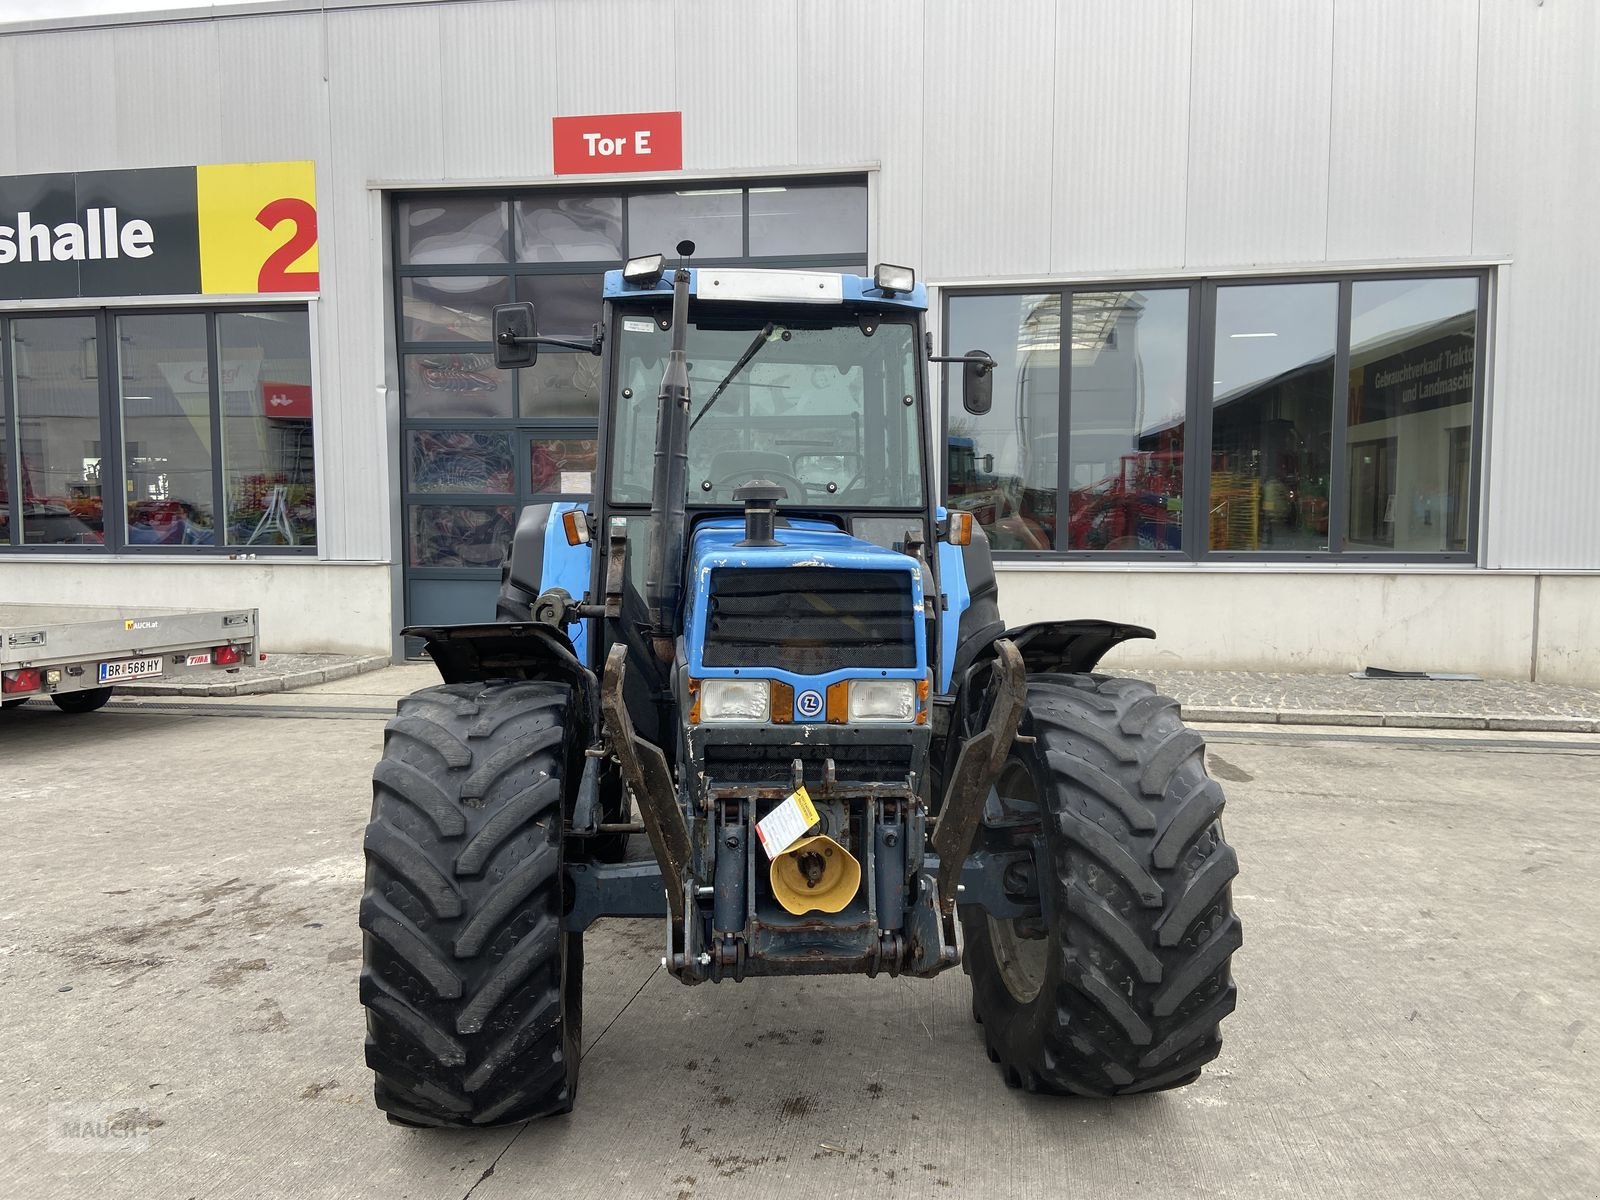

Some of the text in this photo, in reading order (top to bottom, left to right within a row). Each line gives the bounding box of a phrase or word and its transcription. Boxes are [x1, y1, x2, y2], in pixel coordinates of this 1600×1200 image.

[583, 130, 652, 156] Tor E
[255, 197, 319, 293] 2
[1374, 354, 1442, 389] Gebrauchtverkauf
[1402, 384, 1418, 402] und
[108, 659, 160, 677] BR 568 HY
